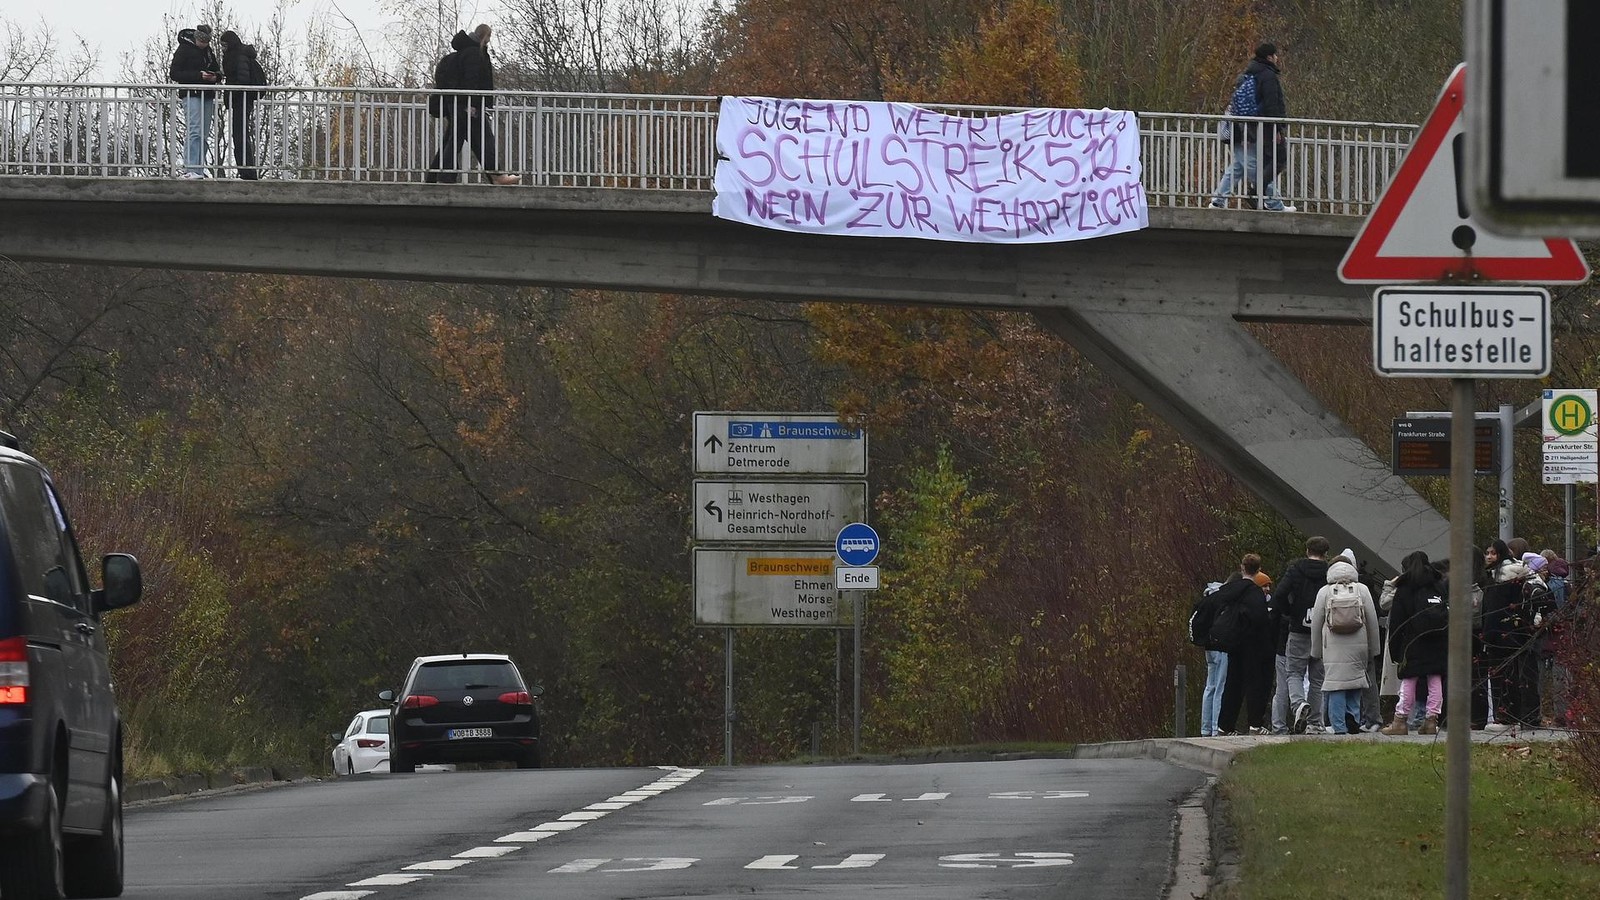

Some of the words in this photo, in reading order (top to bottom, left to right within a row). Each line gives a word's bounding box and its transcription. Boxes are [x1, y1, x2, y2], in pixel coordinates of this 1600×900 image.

[741, 98, 870, 138] JUGEND
[847, 189, 939, 234] ZUR
[1399, 301, 1535, 328] Schulbus-
[1394, 336, 1532, 363] haltestelle
[1562, 403, 1578, 427] H
[737, 426, 748, 434] 39
[778, 426, 857, 438] Braunschweg
[728, 443, 776, 453] Zentrum
[728, 457, 790, 467] Detmerode
[749, 493, 810, 505] Westhagen
[727, 524, 807, 533] Gesamtschule
[750, 561, 830, 575] Braunschweig
[844, 574, 870, 583] Ende
[794, 580, 833, 590] Ehmen
[798, 593, 833, 604] Mörse
[771, 608, 833, 620] Westhagen
